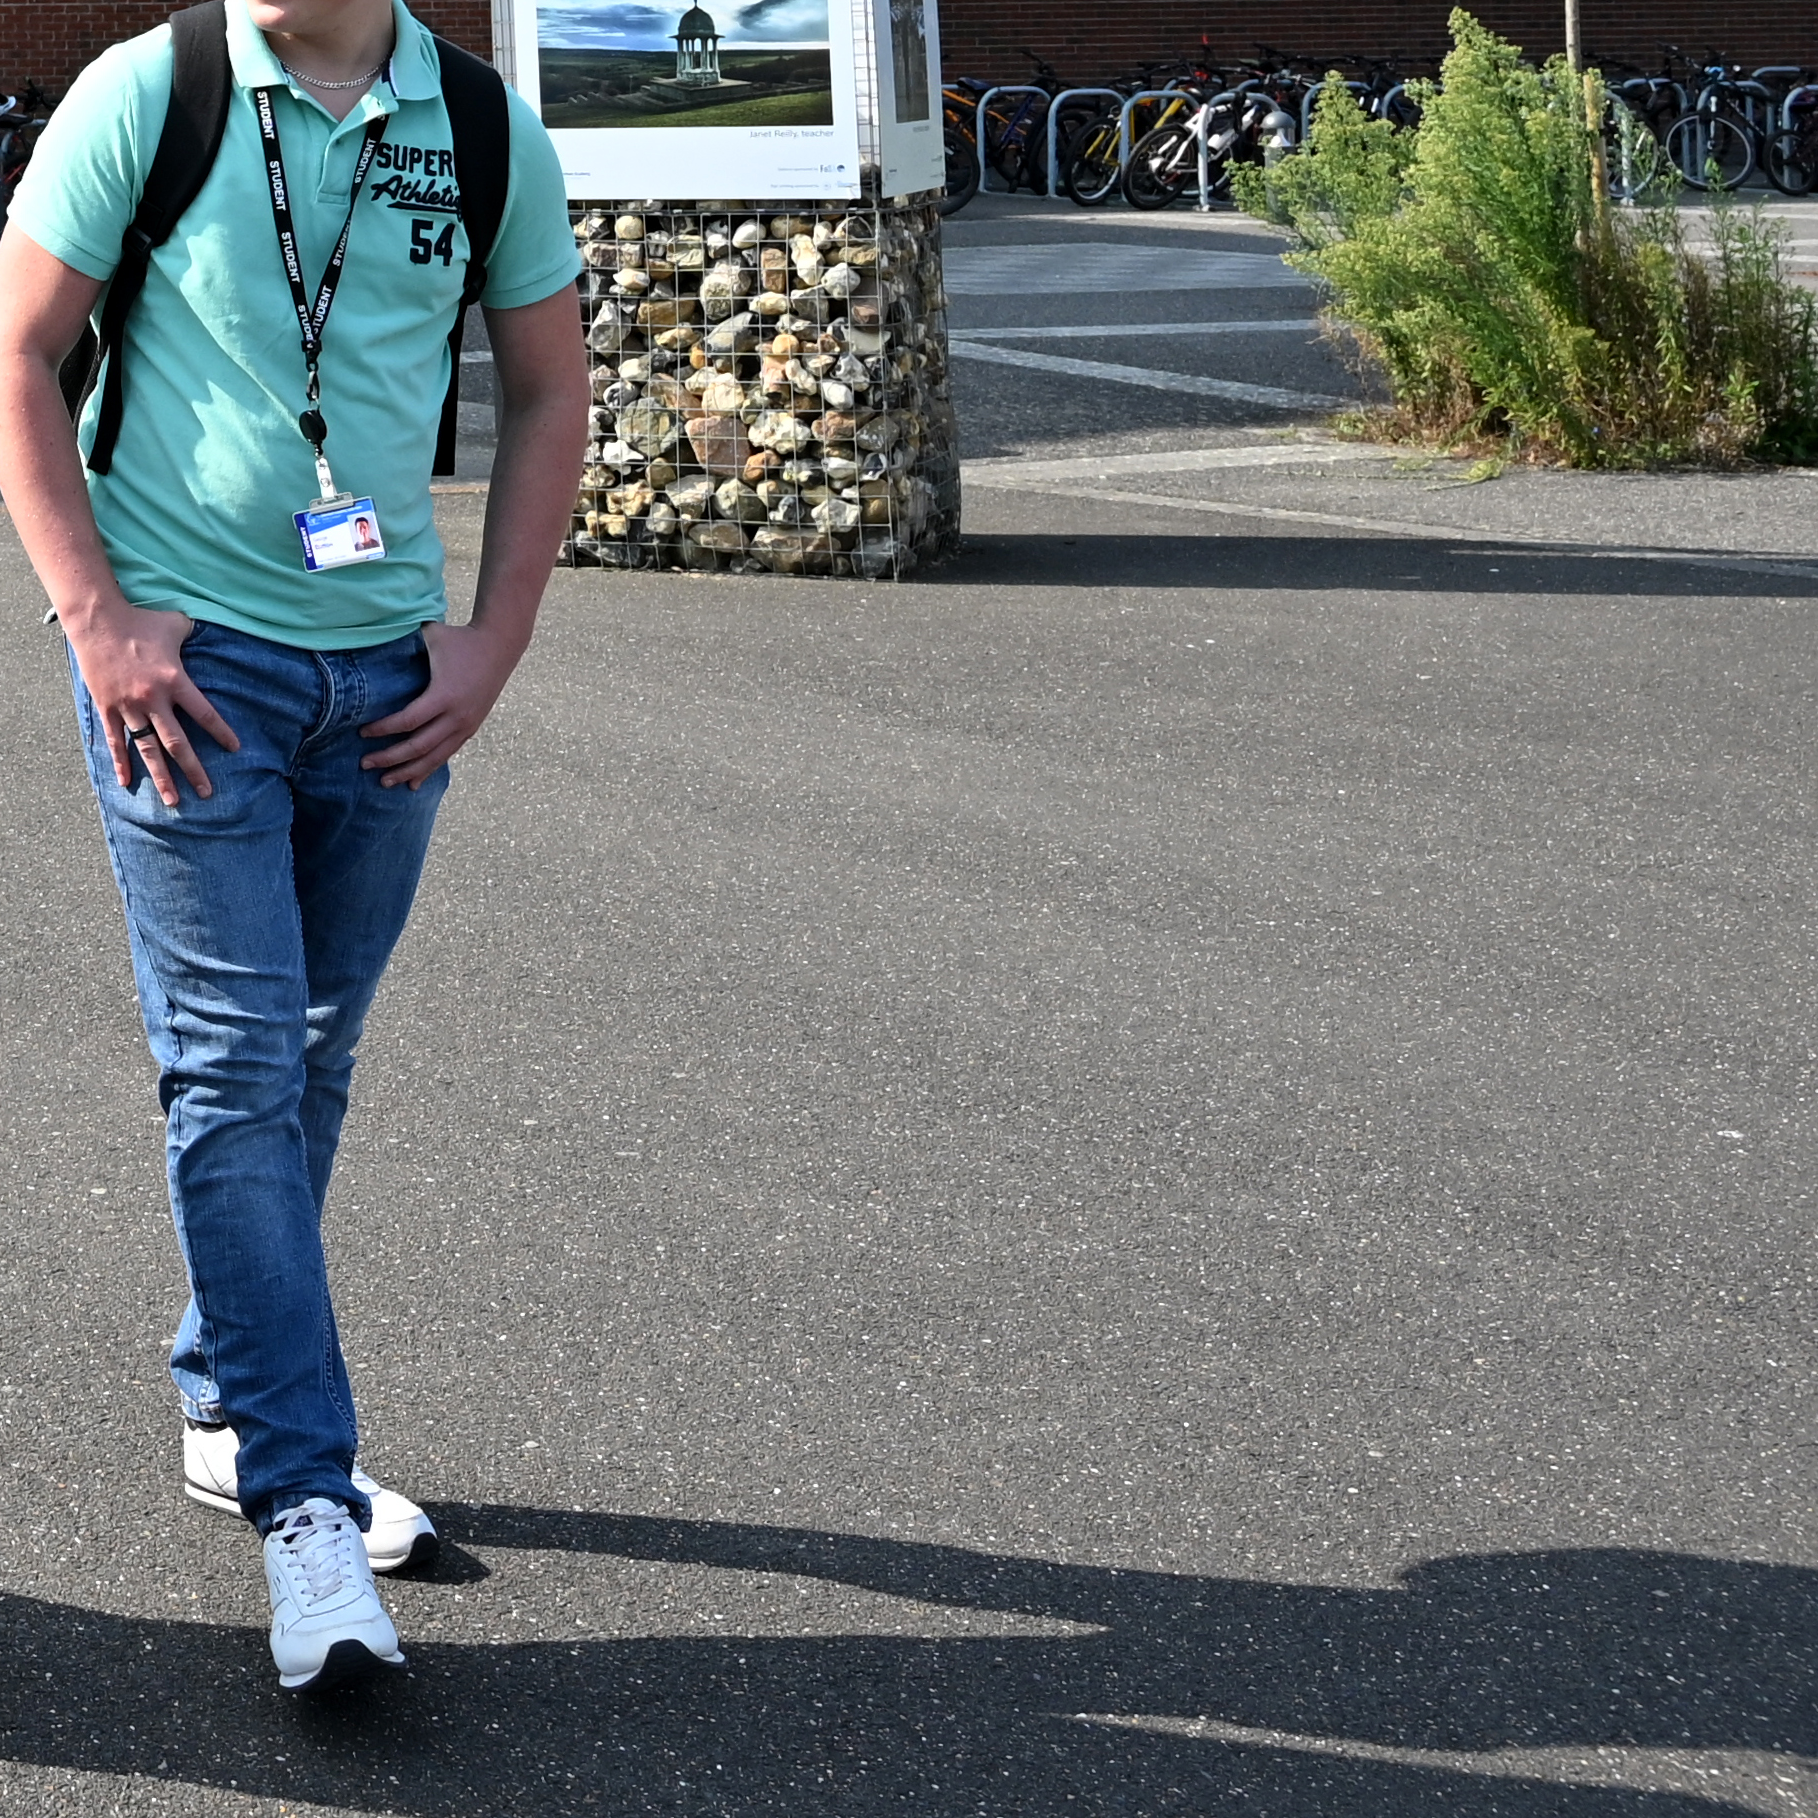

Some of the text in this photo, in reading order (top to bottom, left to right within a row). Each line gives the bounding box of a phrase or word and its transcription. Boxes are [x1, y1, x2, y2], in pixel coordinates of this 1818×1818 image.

[257, 91, 275, 140] STUDENT
[354, 137, 377, 184] STUDENT
[376, 142, 454, 178] SUPER
[270, 160, 286, 211] STUDENT
[281, 231, 301, 283] STUDENT
[409, 218, 456, 268] 54
[298, 304, 314, 342] STUDE
